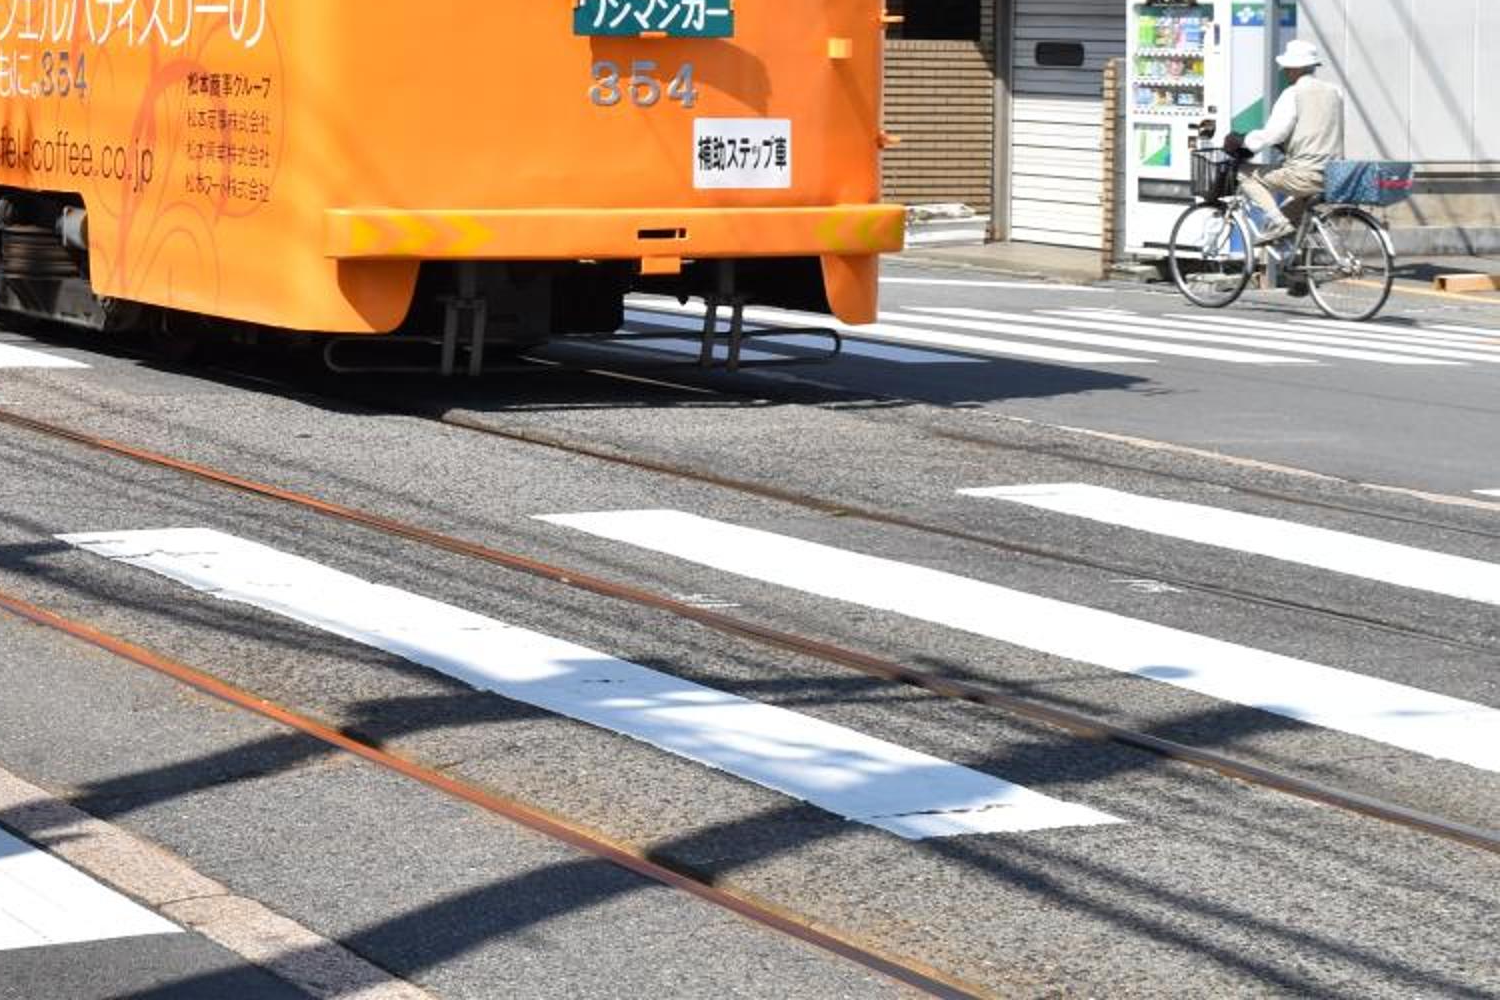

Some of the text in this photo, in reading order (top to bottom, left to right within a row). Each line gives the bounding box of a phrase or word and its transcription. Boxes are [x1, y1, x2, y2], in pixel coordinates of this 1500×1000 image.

[41, 51, 87, 99] 354
[589, 59, 699, 109] 354
[697, 135, 787, 171] 補助ステップ車
